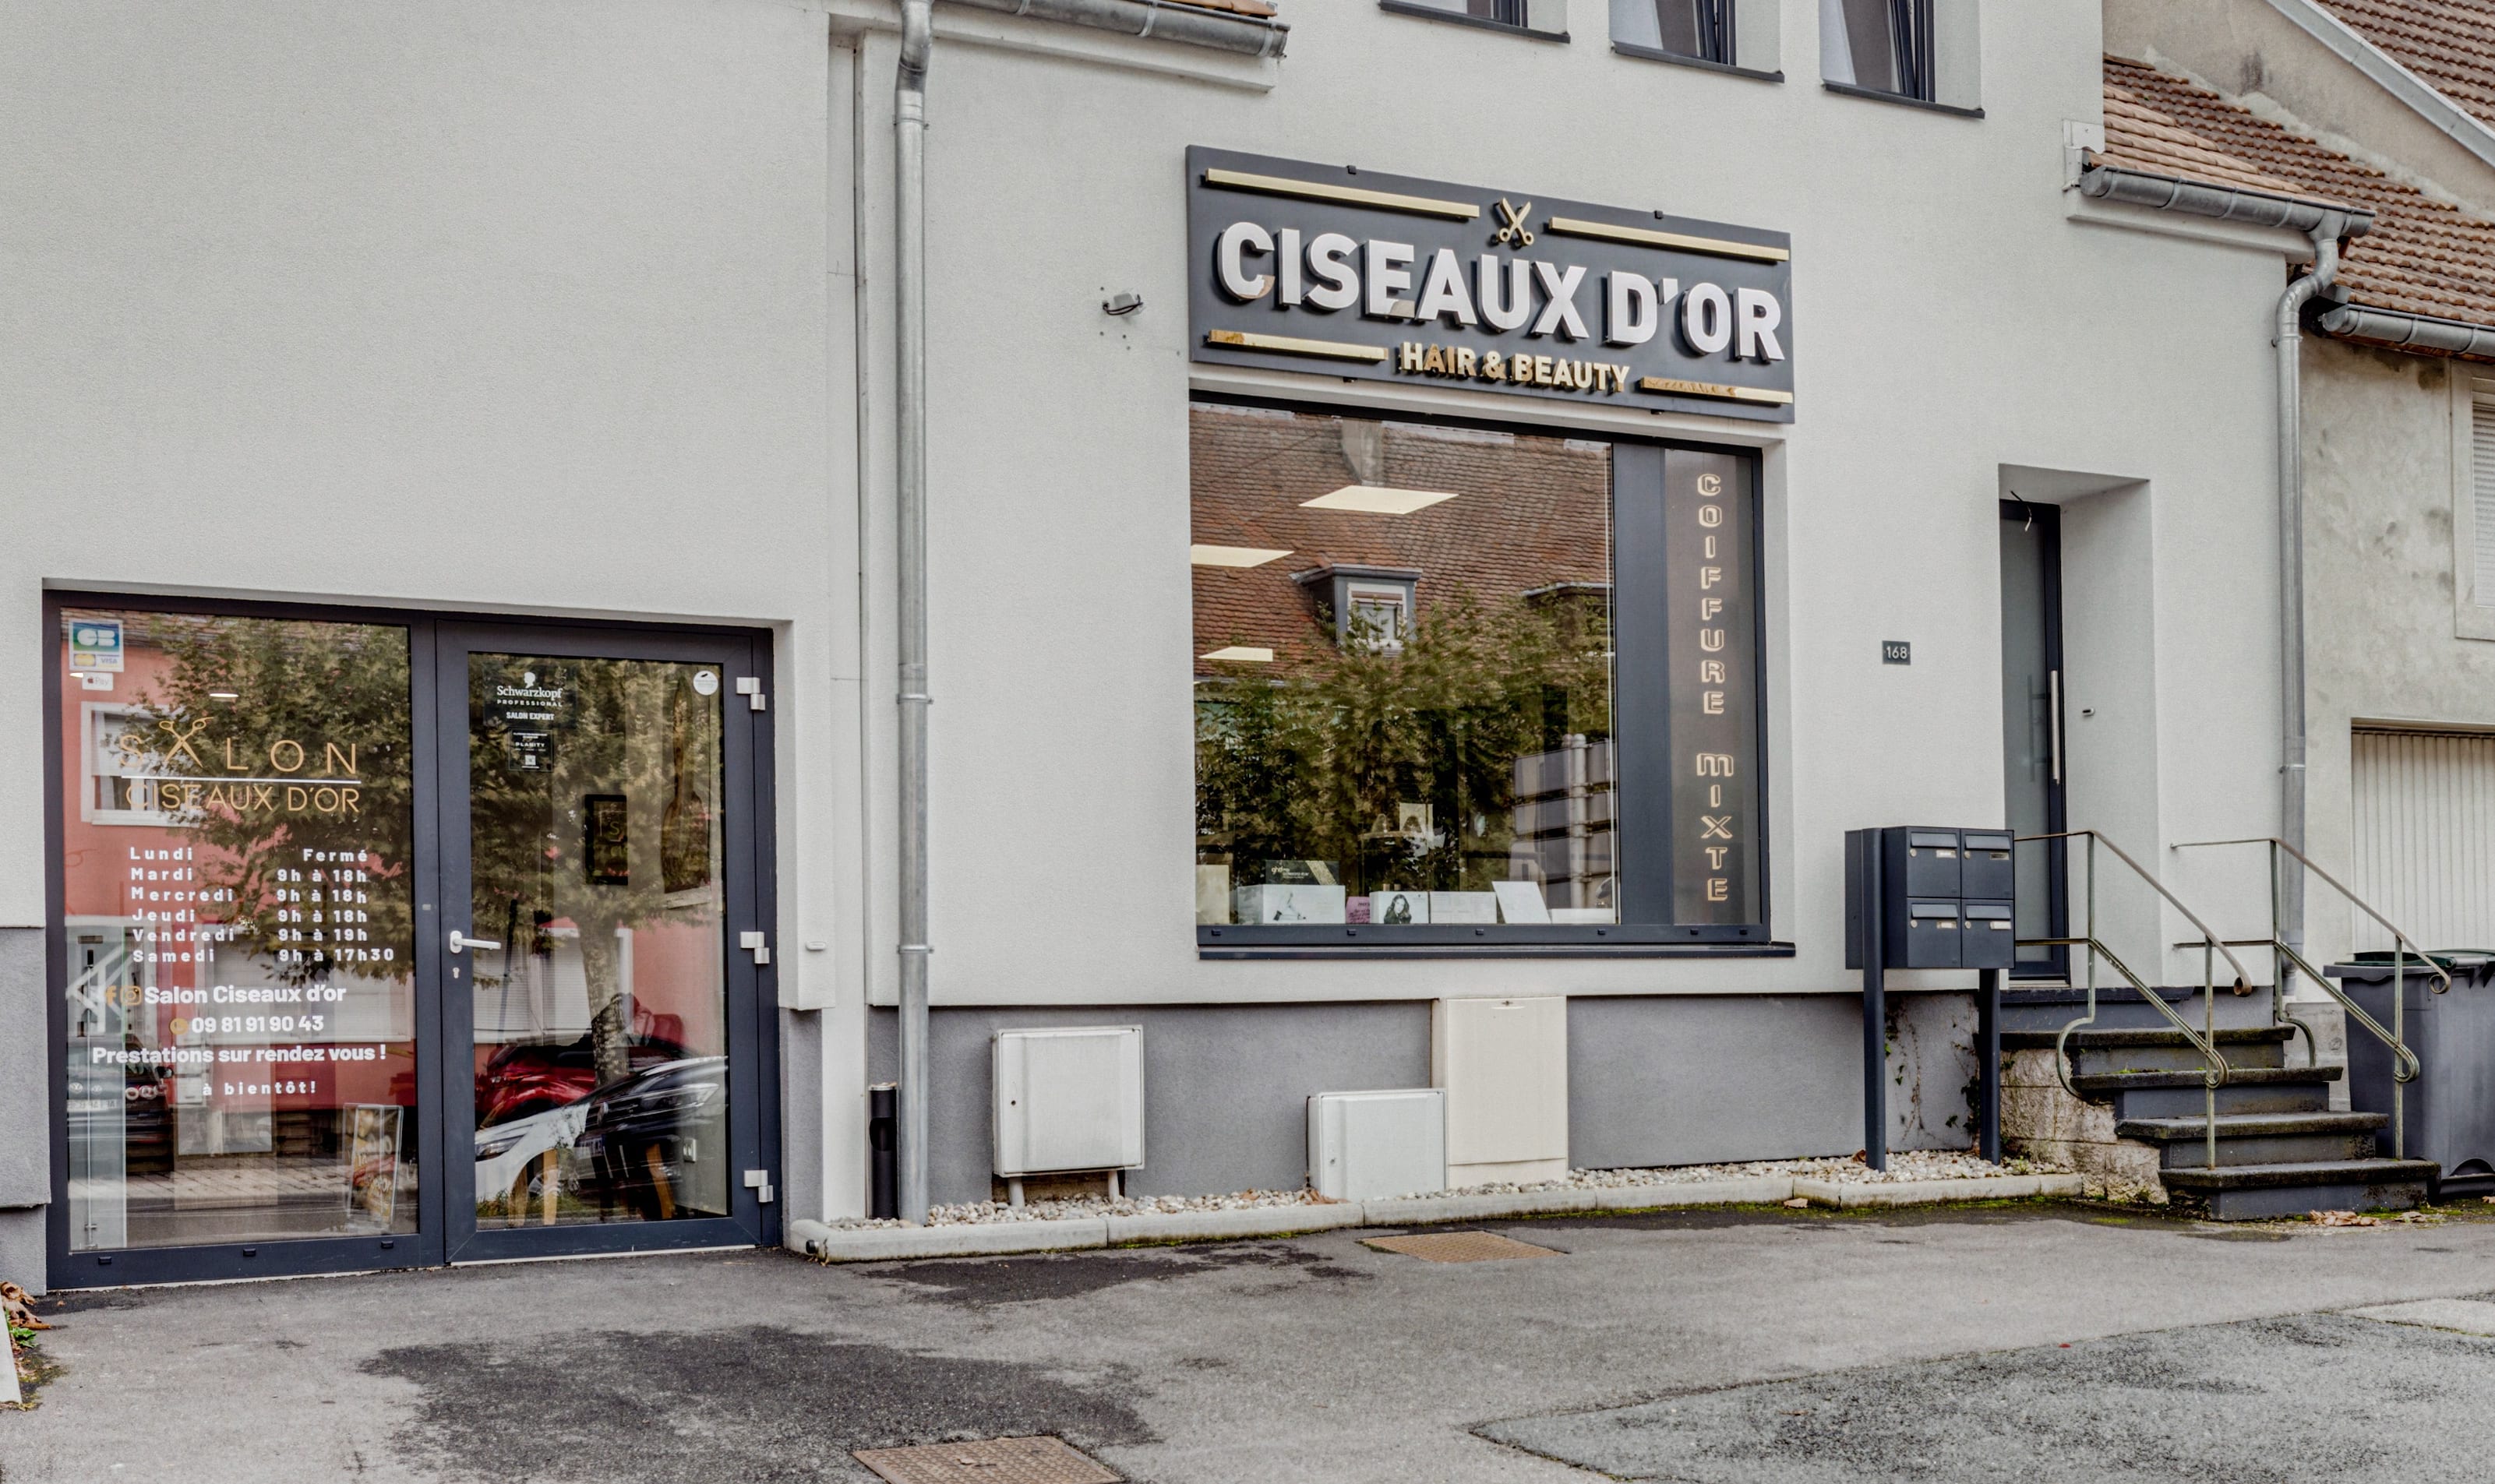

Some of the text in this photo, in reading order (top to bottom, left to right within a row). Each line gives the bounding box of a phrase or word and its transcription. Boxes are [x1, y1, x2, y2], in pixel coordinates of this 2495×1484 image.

[1218, 222, 1785, 362] CISEAUX D'OR
[1399, 341, 1630, 393] HAIR & BEAUTY
[1697, 473, 1726, 715] COIFFURE
[76, 629, 116, 647] CB
[1886, 645, 1907, 659] 168
[496, 685, 563, 701] Schwarzkopf
[506, 711, 555, 721] SALON EXPERT
[125, 782, 361, 812] CISEAUX D'OR
[130, 847, 369, 862] Lundi Fermé
[130, 867, 368, 883] Mardi 9h à 18h
[131, 887, 367, 904] Mercredi 9h à 18h
[132, 908, 368, 923] Jeudi 9h à 18h
[132, 928, 368, 942] Vendredi 9h à 19h
[132, 948, 394, 963] Samedi 9h à 17h30
[144, 984, 208, 1004] Salon
[213, 985, 302, 1003] Ciseaux
[306, 984, 347, 1003] d'or
[192, 1015, 324, 1034] 09 81 91 90 43
[93, 1047, 214, 1064] Prestations
[218, 1049, 252, 1063] sur
[256, 1046, 325, 1063] rendez
[328, 1046, 376, 1062] vous
[202, 1080, 316, 1096] à bientôt!
